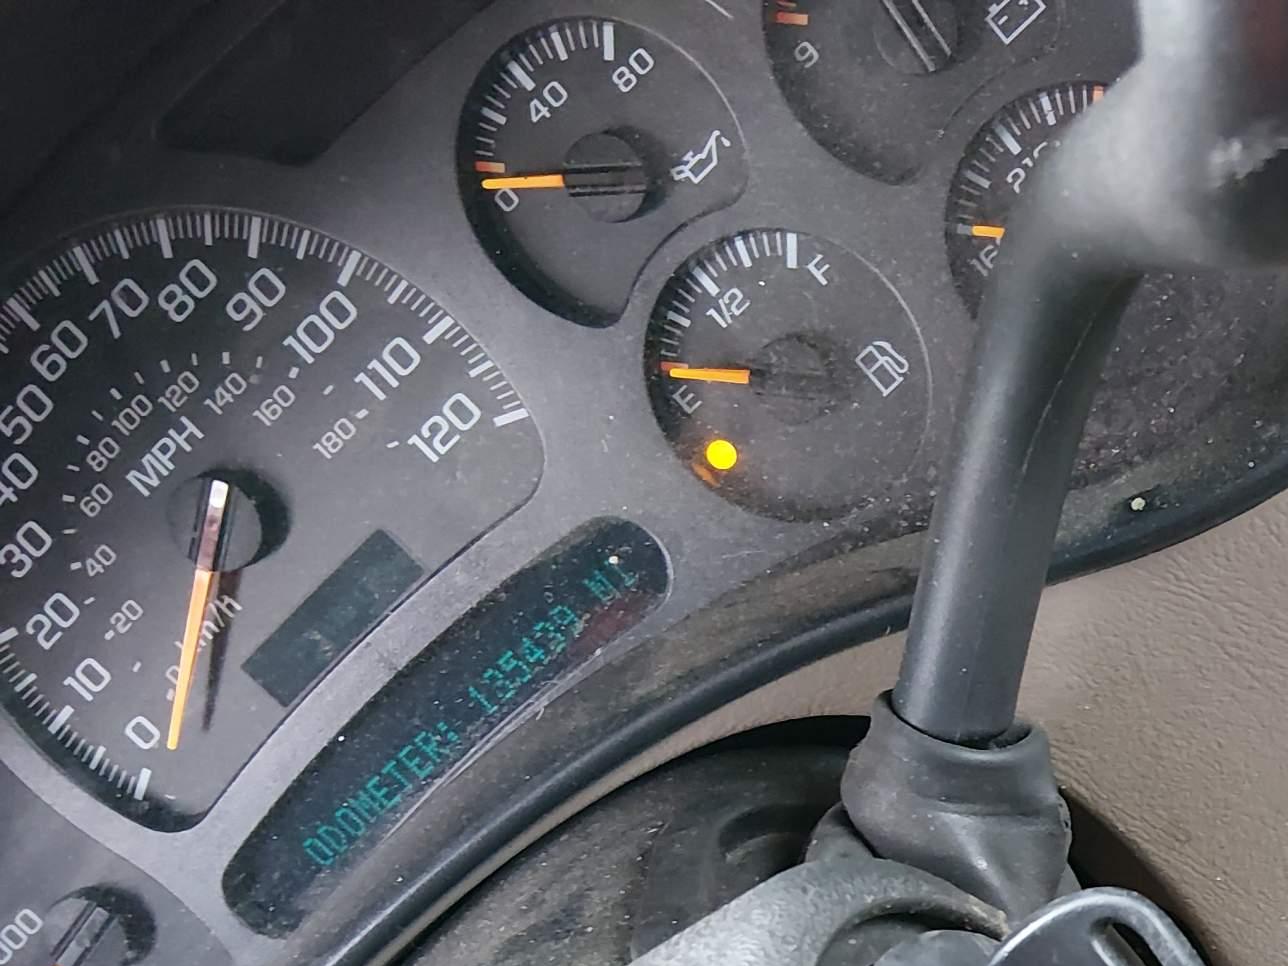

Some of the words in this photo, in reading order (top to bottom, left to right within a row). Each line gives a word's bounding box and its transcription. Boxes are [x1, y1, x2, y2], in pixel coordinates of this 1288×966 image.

[612, 47, 655, 93] 80
[793, 41, 820, 68] 9
[528, 80, 568, 124] 40
[495, 188, 519, 212] 0
[157, 259, 218, 323] 80
[806, 254, 831, 286] F
[88, 278, 149, 339] 70
[225, 267, 286, 332] 90
[706, 287, 750, 328] 1/2
[282, 290, 358, 364] 100
[30, 319, 89, 382] 60
[354, 337, 421, 401] 110
[157, 371, 200, 413] 120
[204, 372, 247, 415] 140
[252, 385, 296, 427] 160
[672, 385, 702, 414] E
[0, 384, 54, 445] 50
[112, 394, 153, 437] 100
[407, 392, 482, 463] 120
[86, 437, 120, 473] 80
[125, 415, 205, 498] MPH
[313, 417, 357, 460] 180
[80, 482, 113, 517] 60
[0, 521, 52, 578] 30
[85, 544, 117, 577] 40
[26, 592, 80, 650] 20
[110, 599, 144, 634] 20
[174, 594, 244, 653] m/h
[63, 657, 112, 701] 10
[124, 715, 161, 750] 0
[303, 721, 460, 866] ODOMETER:
